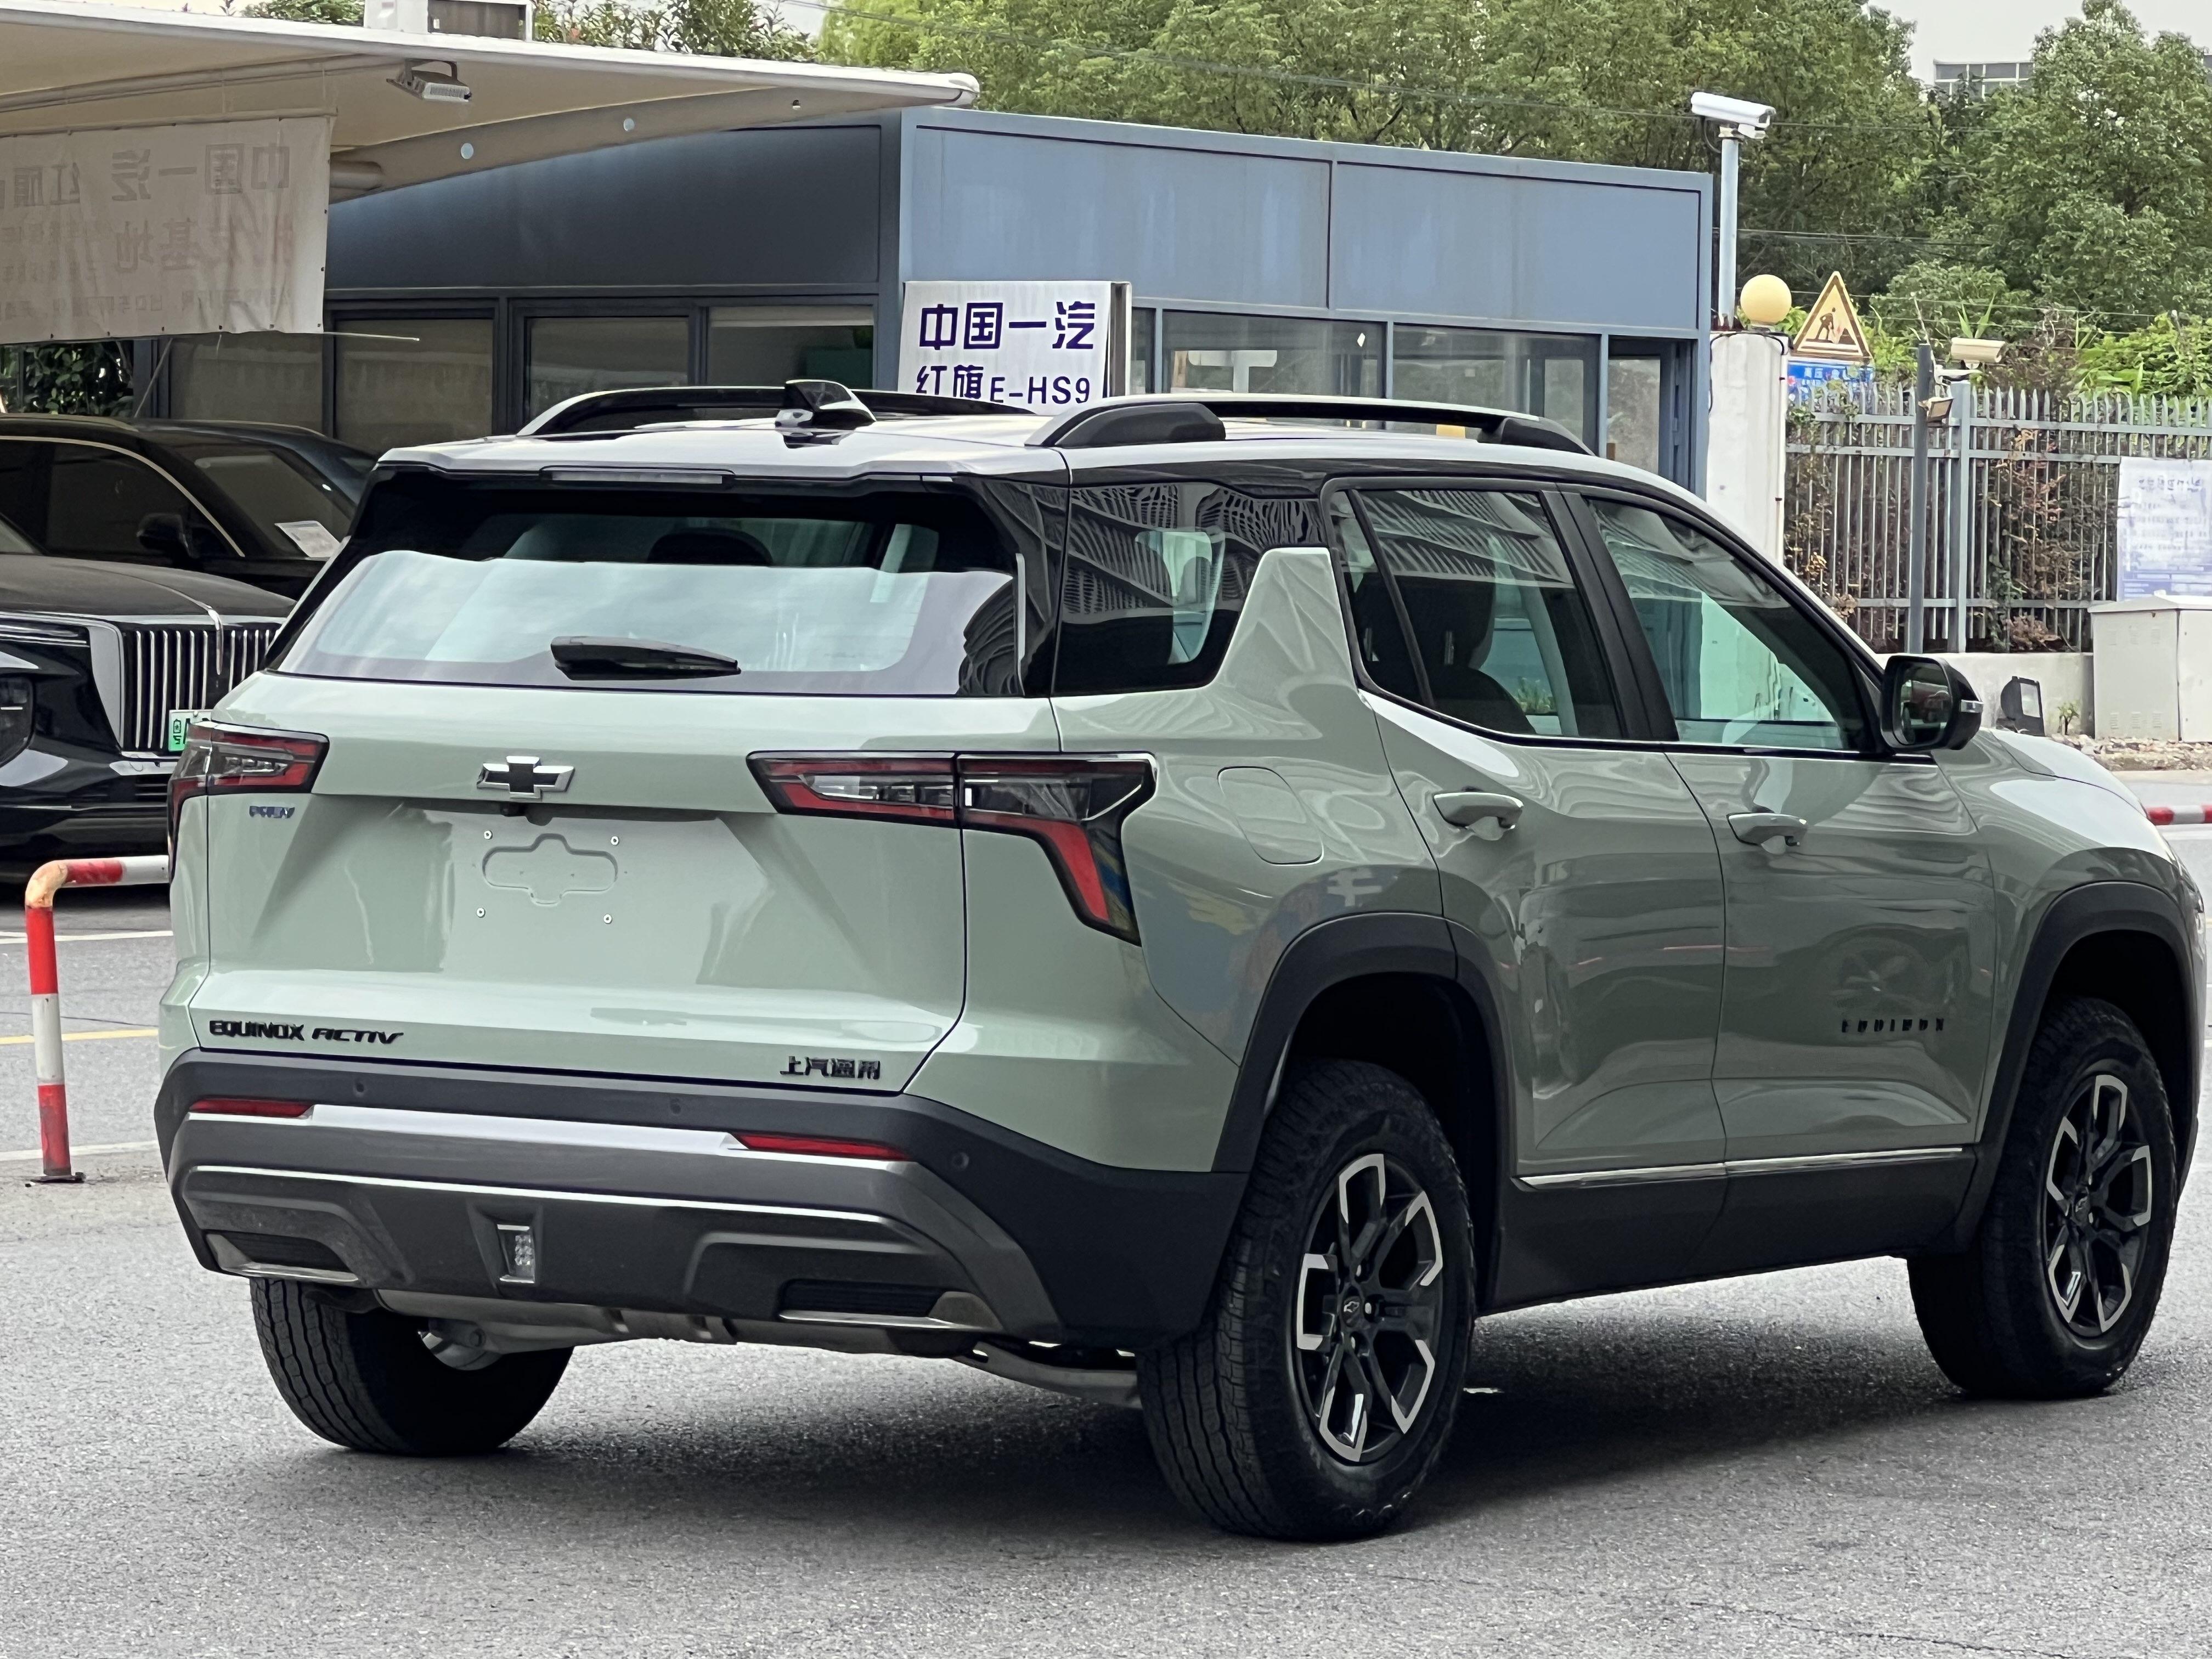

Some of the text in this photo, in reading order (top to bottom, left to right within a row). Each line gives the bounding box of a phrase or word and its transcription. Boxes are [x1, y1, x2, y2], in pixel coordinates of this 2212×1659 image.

[919, 301, 1096, 351] 中国一汽
[916, 364, 1091, 404] 红旗E-HS9
[209, 1019, 404, 1045] EQUINOX ACTIV
[779, 1056, 881, 1080] 上汽通用
